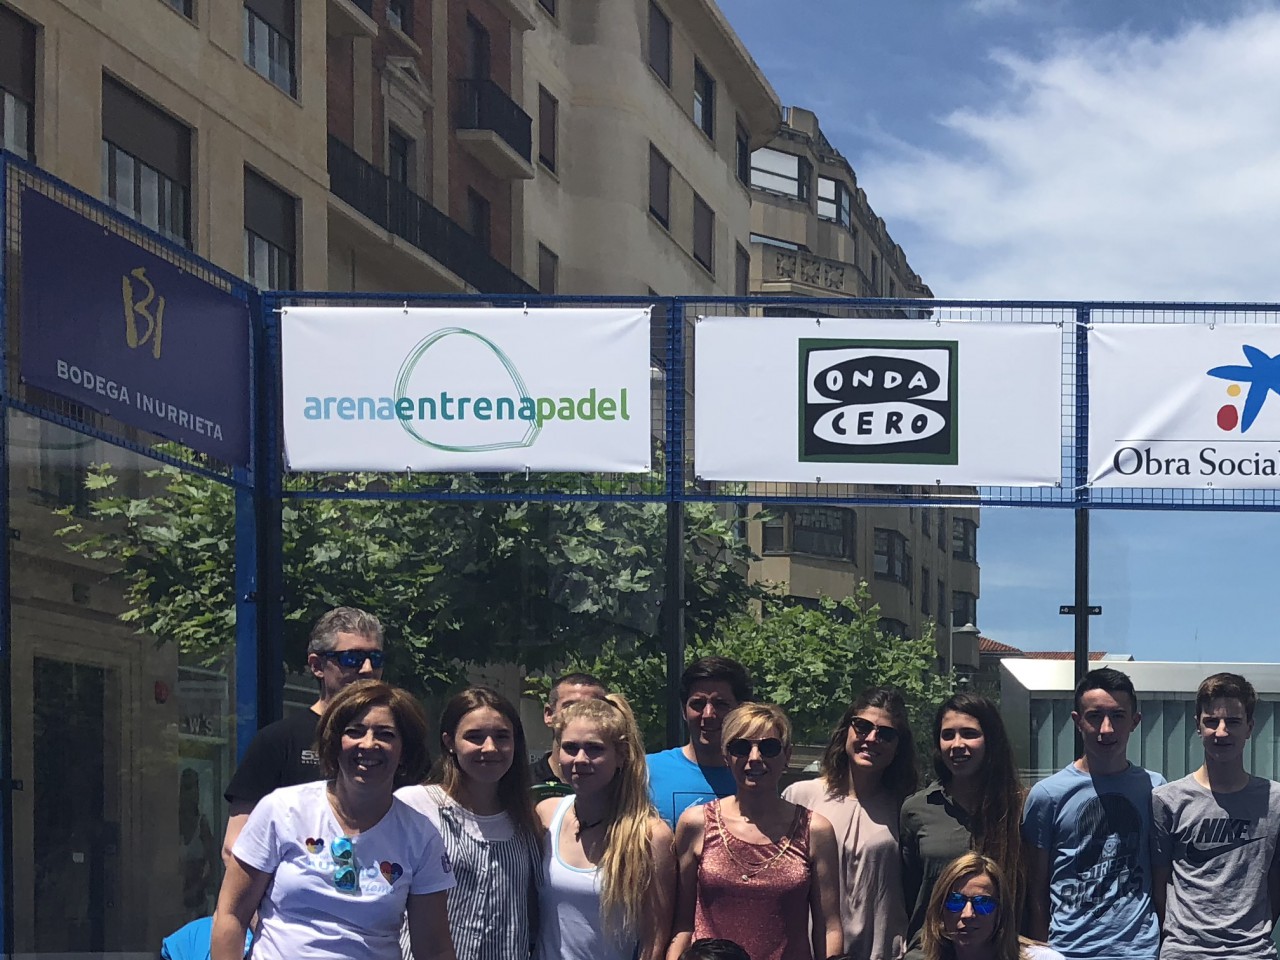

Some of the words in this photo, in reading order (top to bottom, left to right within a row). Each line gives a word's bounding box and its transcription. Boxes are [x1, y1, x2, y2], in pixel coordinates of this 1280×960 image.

[825, 368, 930, 393] ONDA
[56, 358, 131, 405] BODEGA
[135, 395, 224, 442] INURRIETA
[302, 388, 631, 429] arenaentrenapadel
[831, 408, 929, 437] CERO
[1112, 446, 1192, 477] Obra
[1196, 818, 1252, 844] NIKE
